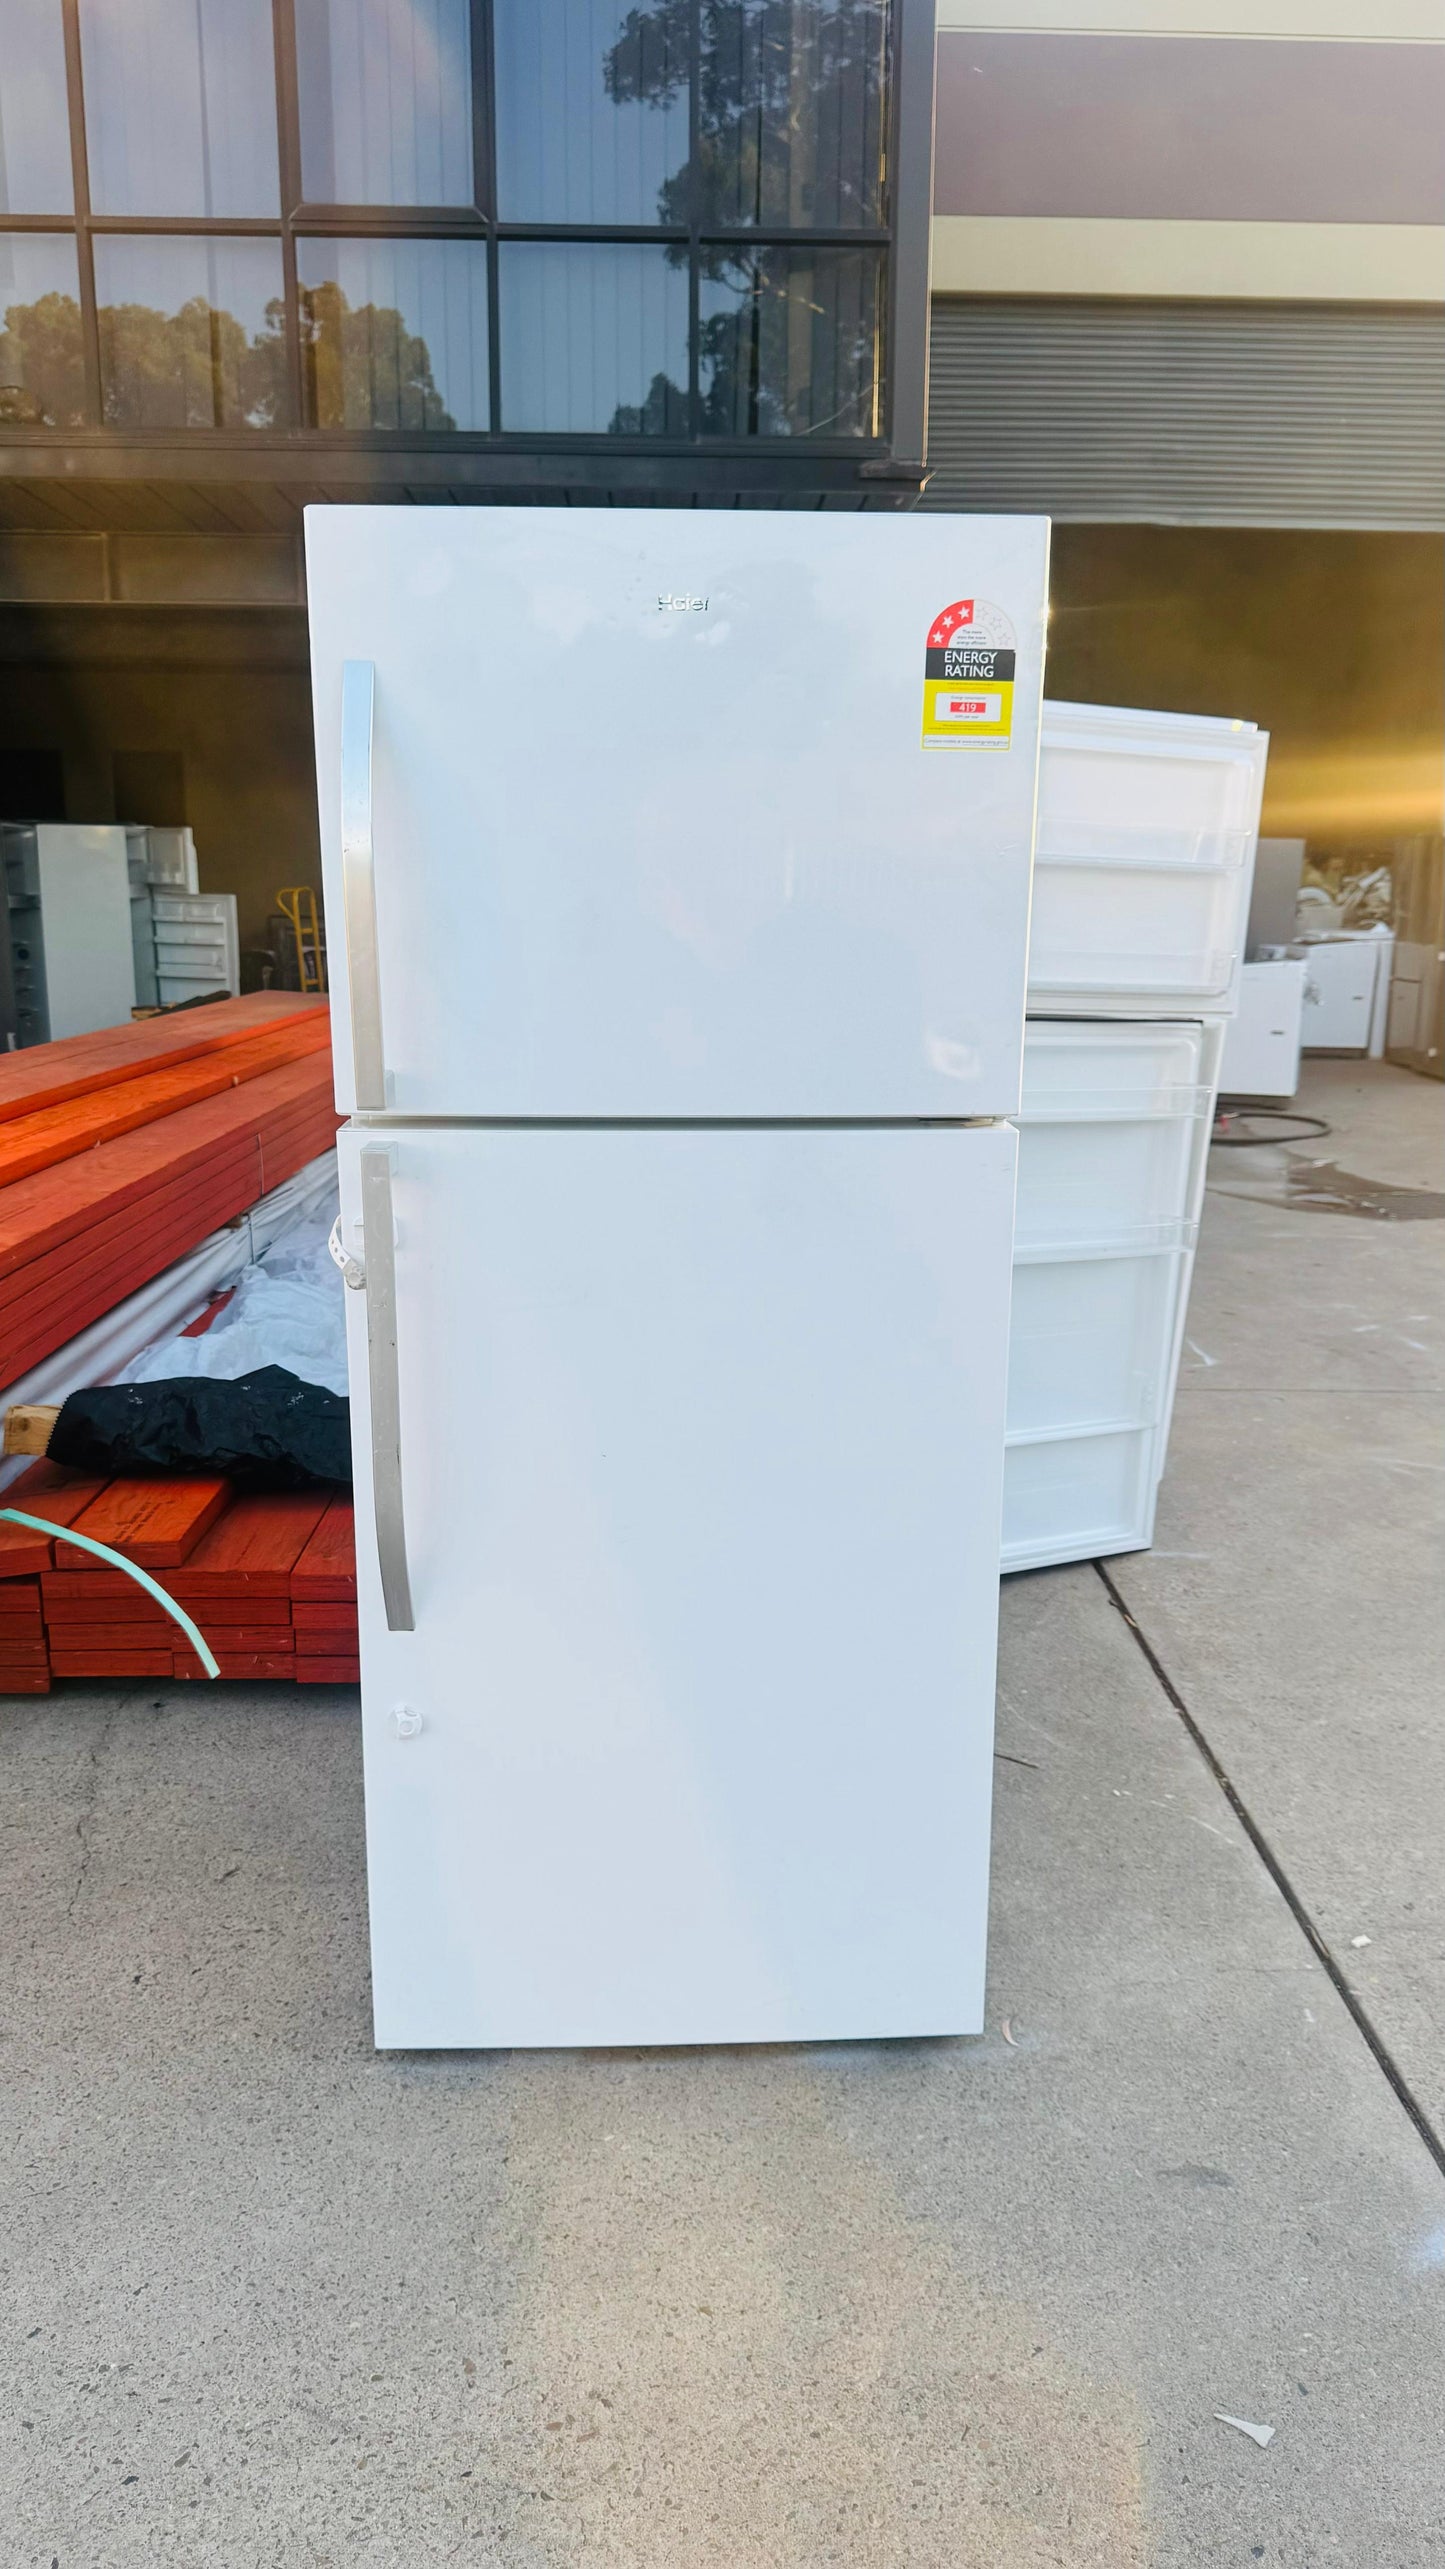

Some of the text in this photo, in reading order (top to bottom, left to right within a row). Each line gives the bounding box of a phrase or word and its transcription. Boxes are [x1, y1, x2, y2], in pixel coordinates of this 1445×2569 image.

[944, 650, 998, 664] ENERGY
[944, 664, 995, 678] RATING
[959, 703, 977, 712] 419
